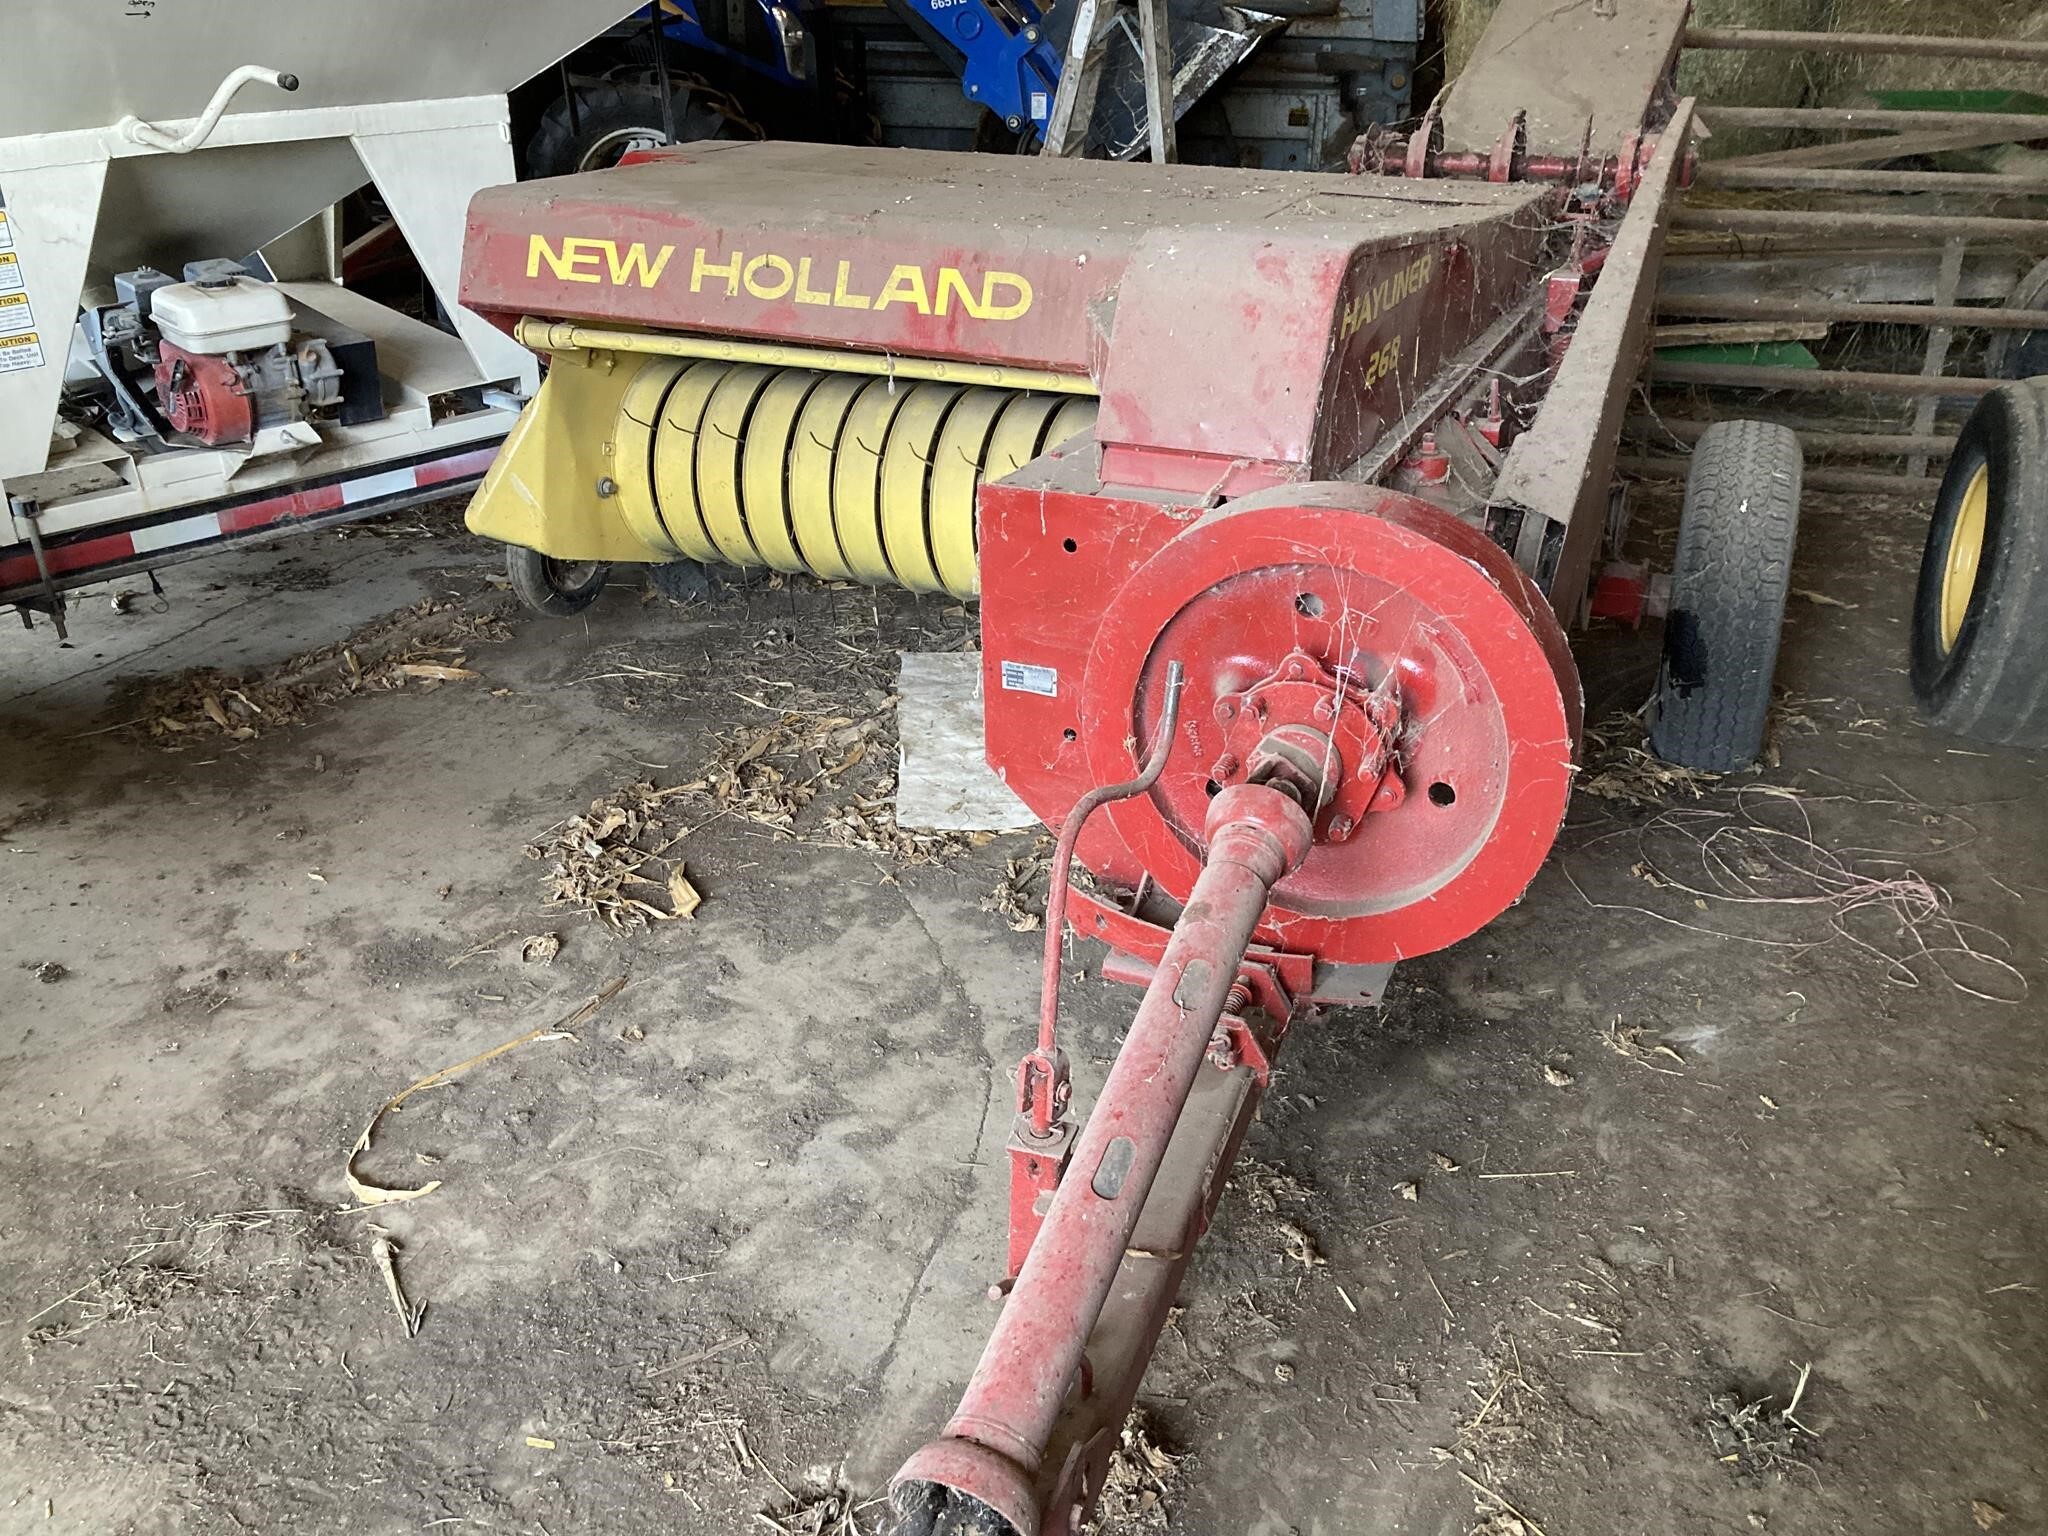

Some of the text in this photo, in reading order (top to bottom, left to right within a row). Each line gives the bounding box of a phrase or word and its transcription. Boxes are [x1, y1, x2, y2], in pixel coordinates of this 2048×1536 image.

[526, 234, 1033, 320] NEW HOLLAND
[1340, 254, 1432, 340] HAYLINER
[1365, 335, 1401, 385] 268
